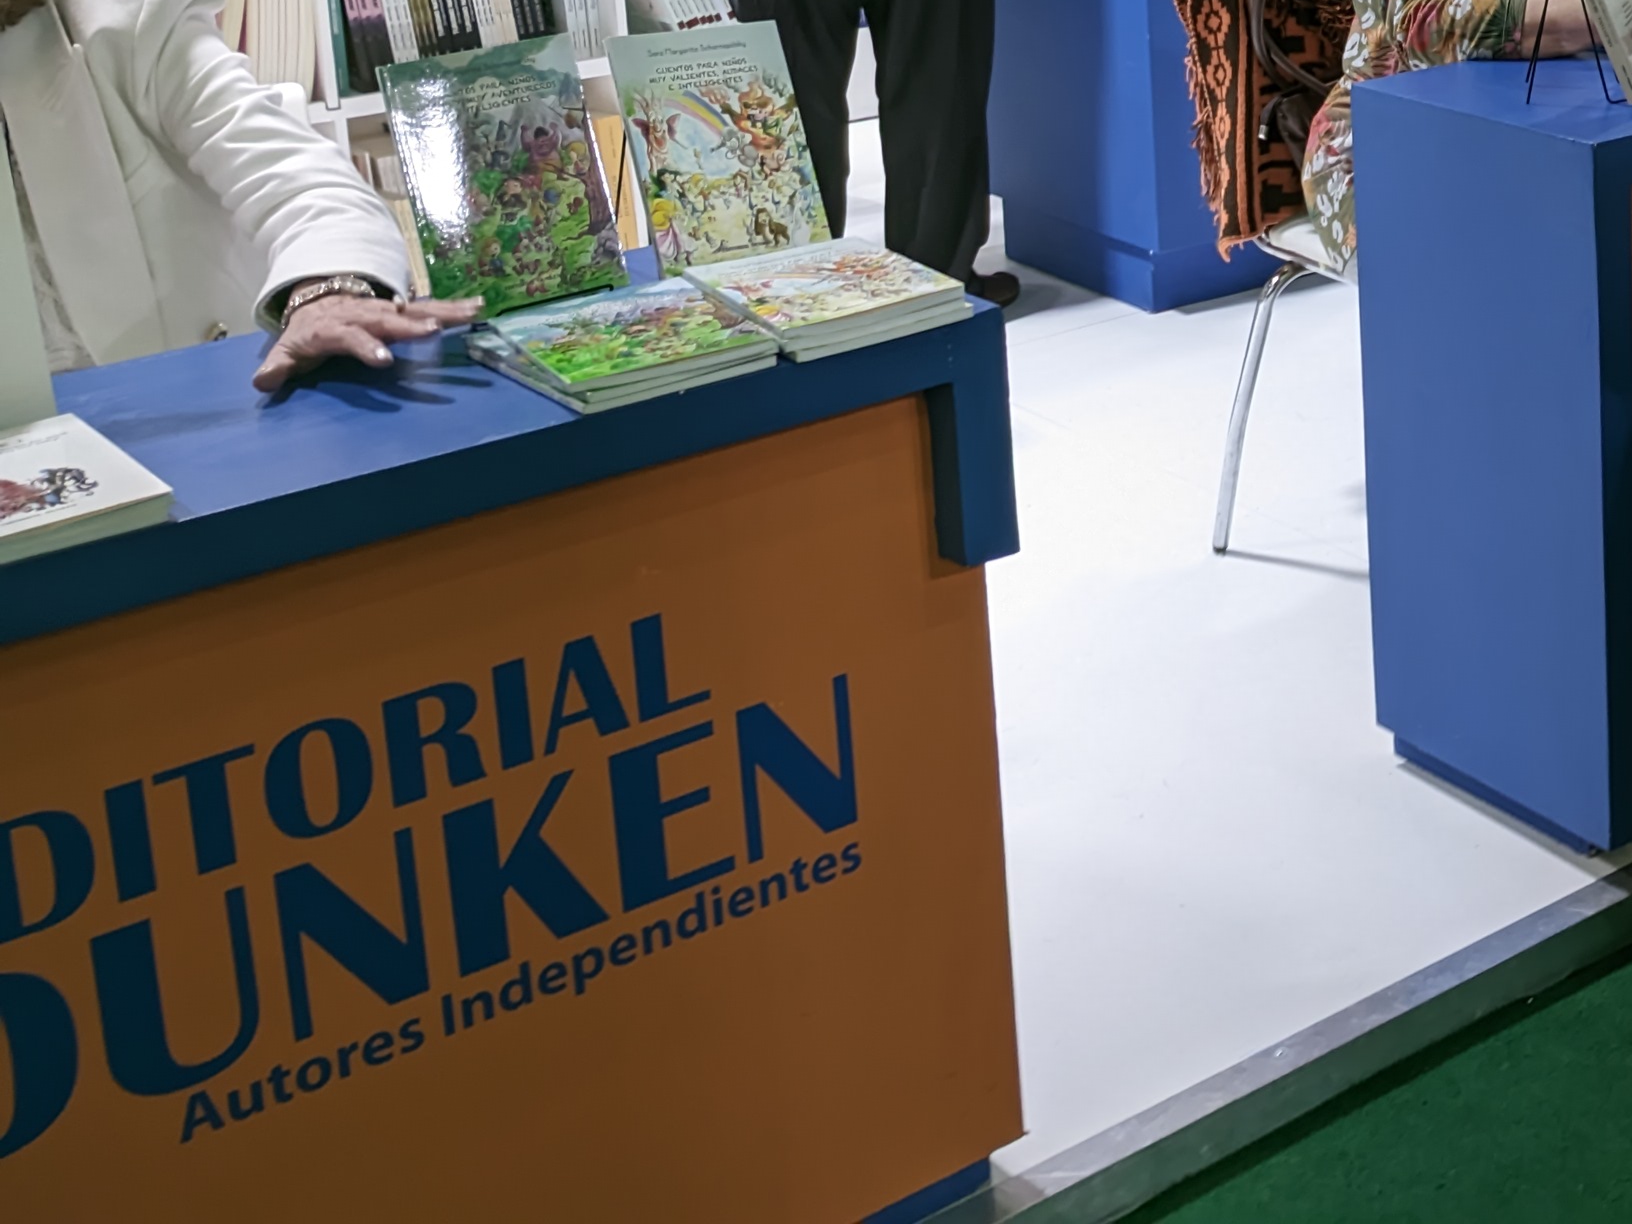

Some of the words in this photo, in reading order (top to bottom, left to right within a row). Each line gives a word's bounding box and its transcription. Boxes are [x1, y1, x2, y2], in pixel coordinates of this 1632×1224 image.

[655, 64, 694, 75] CUENTOS
[696, 61, 719, 70] PARA
[721, 57, 748, 67] NIÑOS
[479, 82, 503, 91] PARA
[648, 76, 667, 84] MUY
[677, 76, 744, 90] INTELIGENTES
[179, 1016, 426, 1145] Autores
[441, 841, 864, 1038] Independientes
